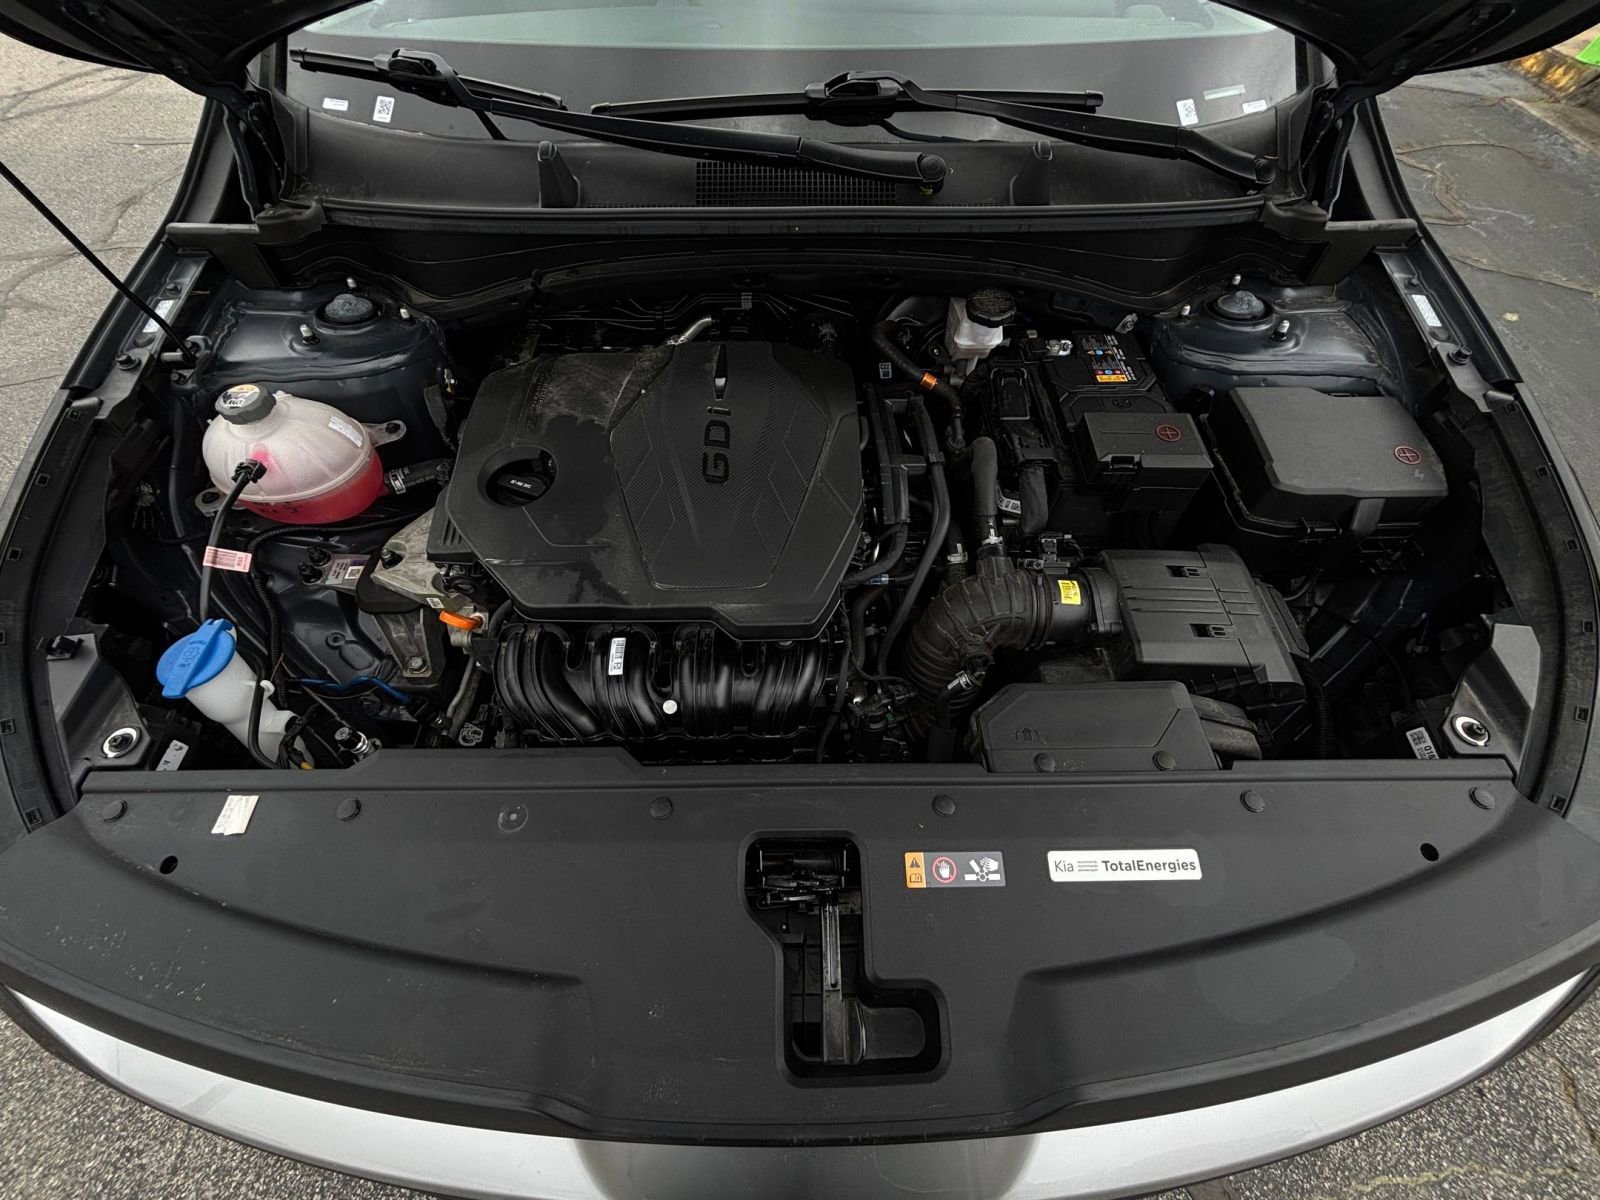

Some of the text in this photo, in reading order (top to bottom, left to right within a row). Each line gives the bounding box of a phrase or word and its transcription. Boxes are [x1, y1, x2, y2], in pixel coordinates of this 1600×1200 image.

[702, 406, 731, 485] GDi
[1054, 860, 1074, 873] Kia
[1102, 859, 1196, 873] TotalEnergies
